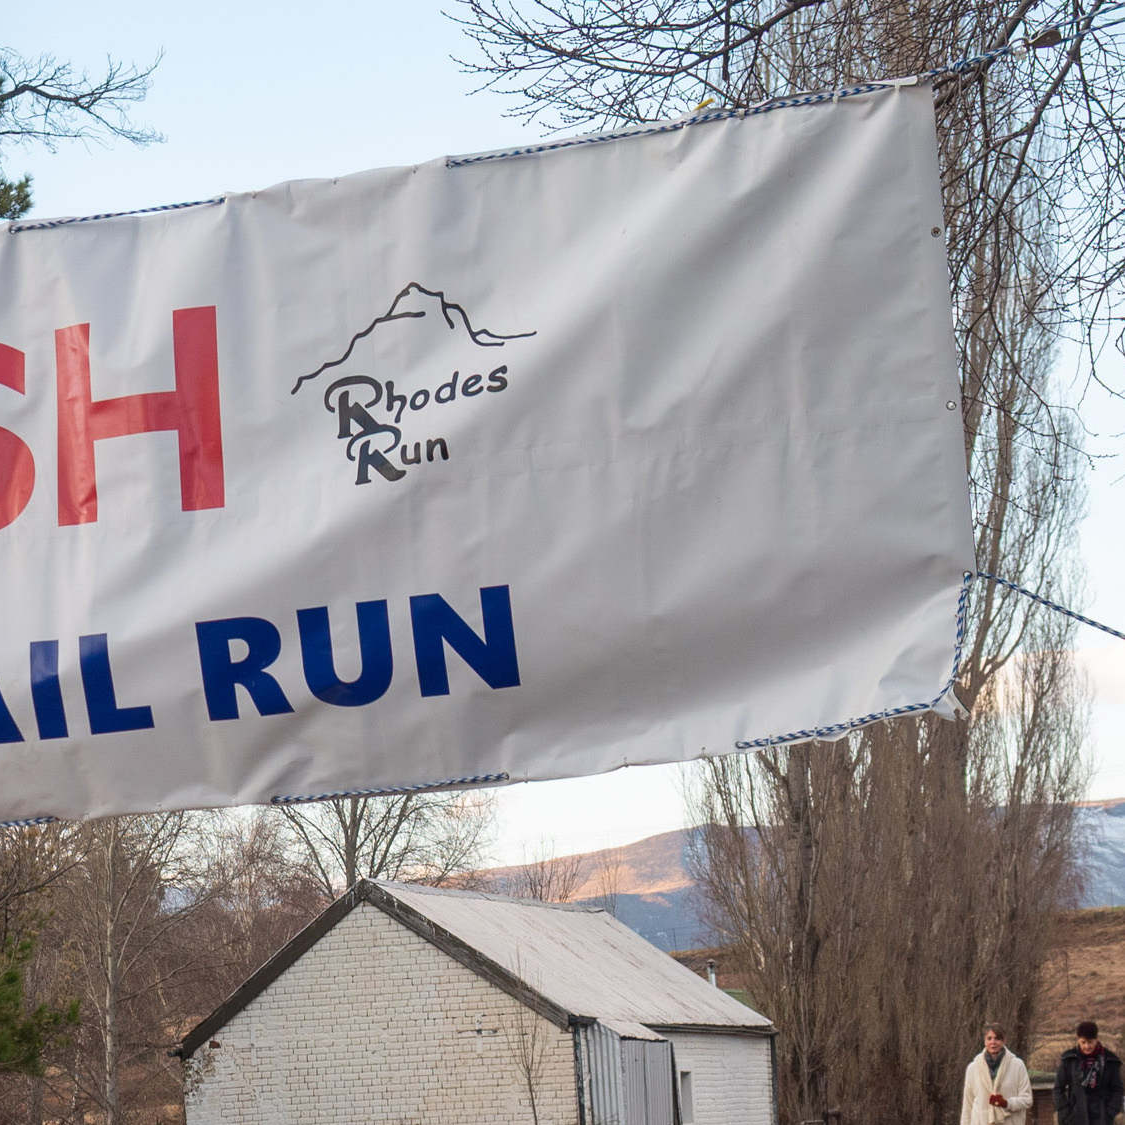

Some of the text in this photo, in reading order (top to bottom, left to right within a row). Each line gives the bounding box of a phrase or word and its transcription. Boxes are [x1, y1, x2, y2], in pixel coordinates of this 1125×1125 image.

[324, 365, 508, 439] Rhodes
[346, 424, 450, 485] Run
[195, 584, 521, 721] RUN
